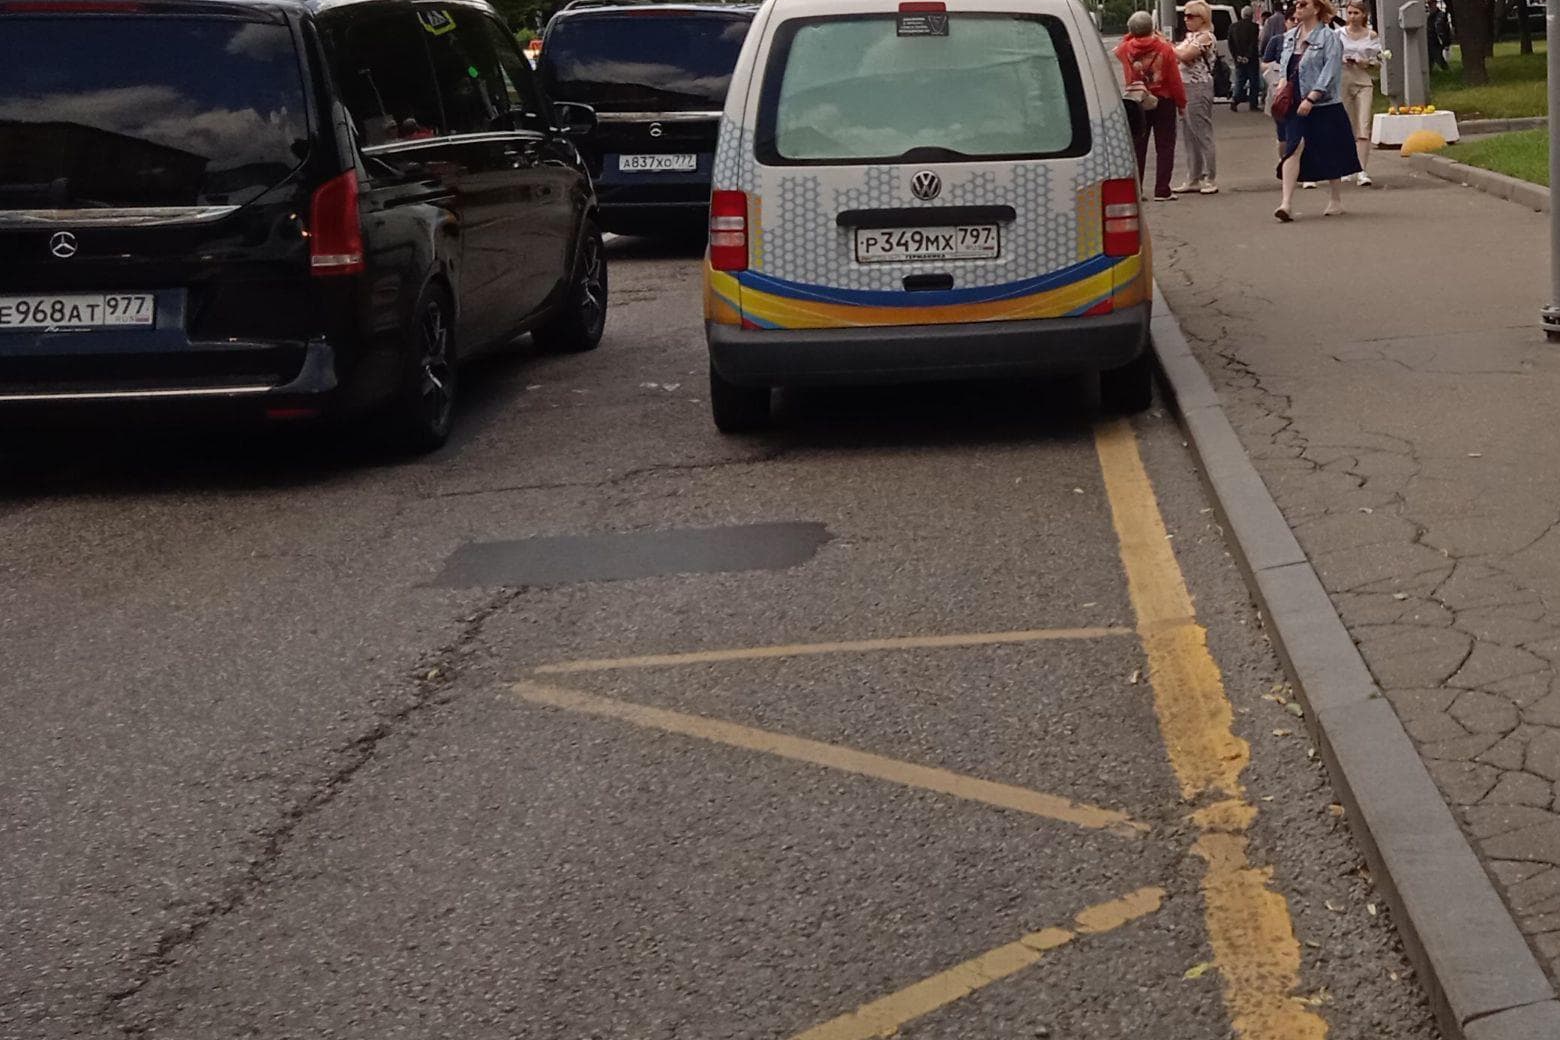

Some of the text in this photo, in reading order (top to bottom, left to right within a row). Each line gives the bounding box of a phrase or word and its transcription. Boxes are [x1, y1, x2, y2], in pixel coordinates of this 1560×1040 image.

[866, 227, 992, 253] Р349МХ 797
[0, 297, 146, 324] Е968АТ 977
